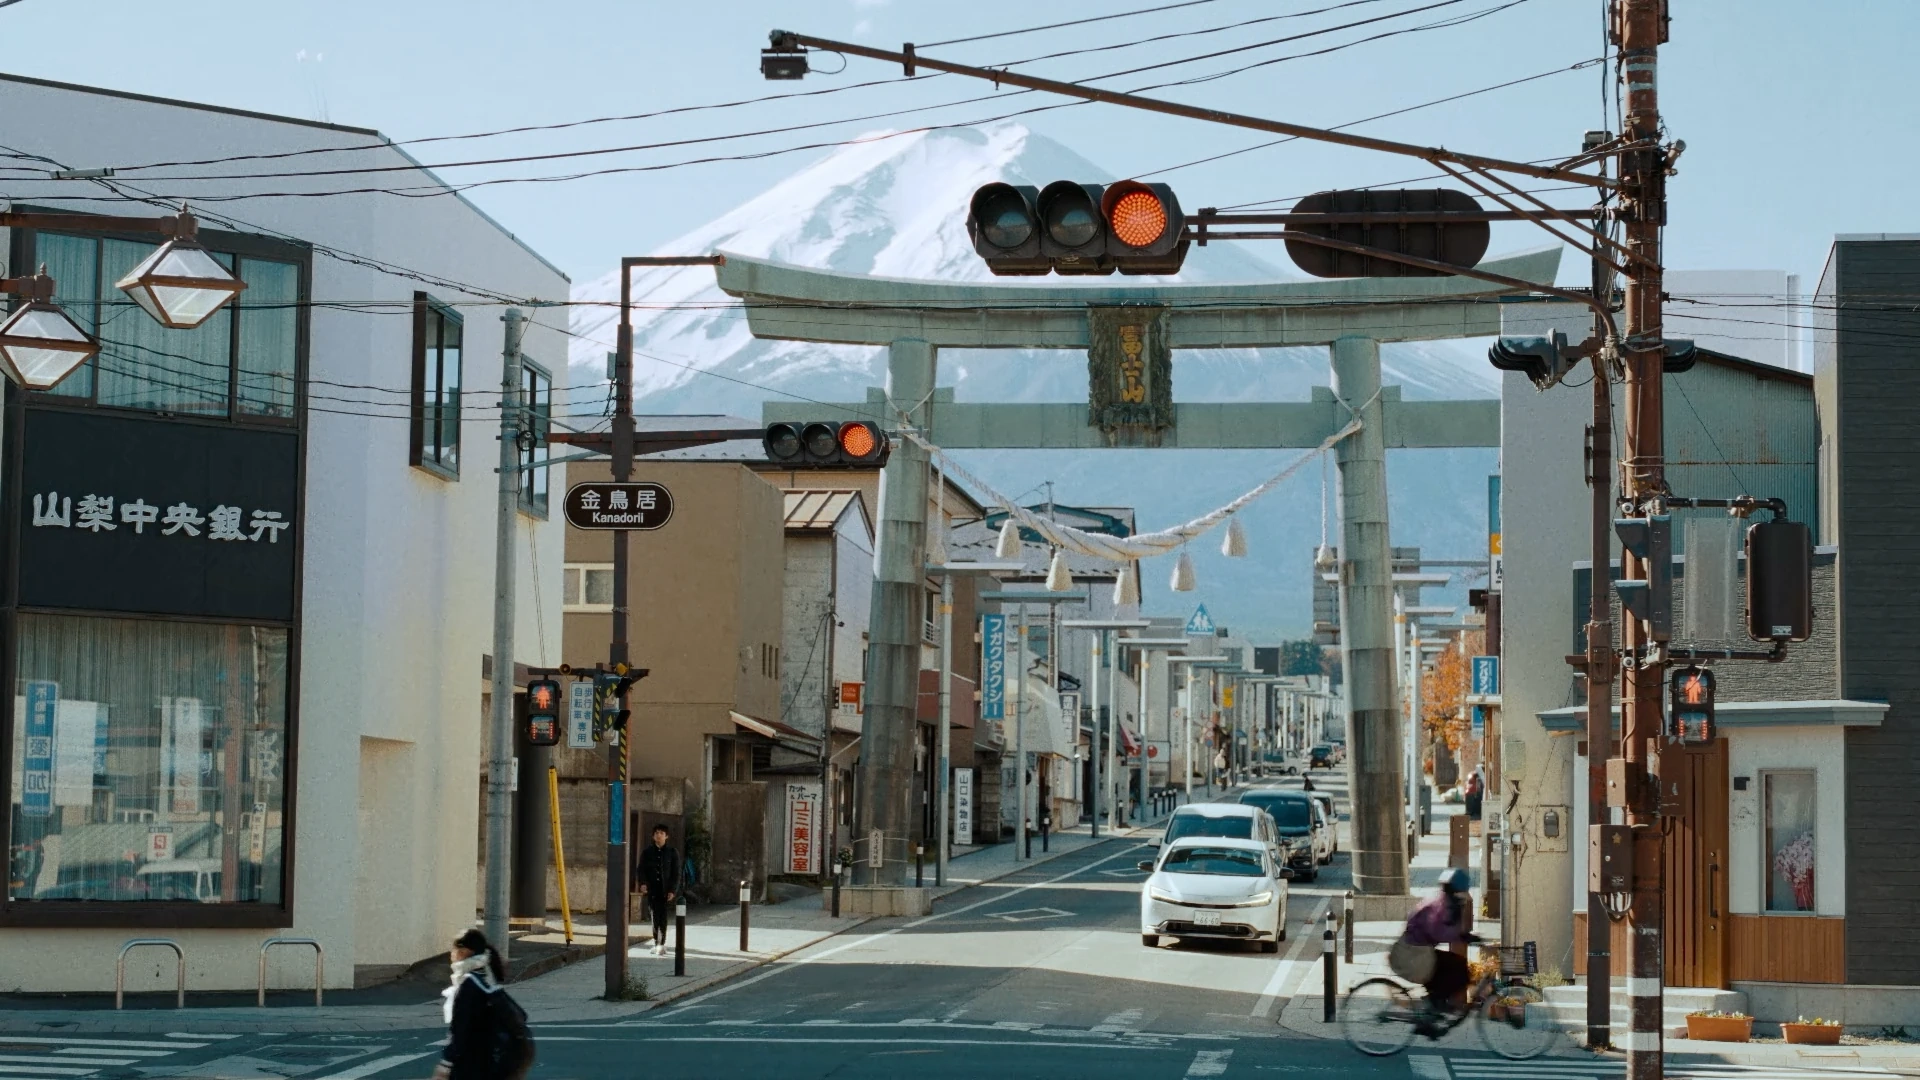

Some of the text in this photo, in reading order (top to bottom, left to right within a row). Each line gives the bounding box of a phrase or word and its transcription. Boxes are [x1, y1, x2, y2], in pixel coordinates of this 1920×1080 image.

[580, 489, 657, 510] 金鳥居
[32, 491, 291, 544] 山梨中央銀行
[592, 512, 644, 523] Kanadorii
[989, 618, 1003, 716] フガクタクシー
[573, 688, 583, 720] 自転車
[584, 688, 593, 720] 歩行者
[577, 721, 587, 743] 専用
[788, 785, 807, 793] カット
[797, 793, 818, 801] パーマ
[959, 774, 969, 832] 山口染物店
[793, 801, 811, 872] ユミ美容室
